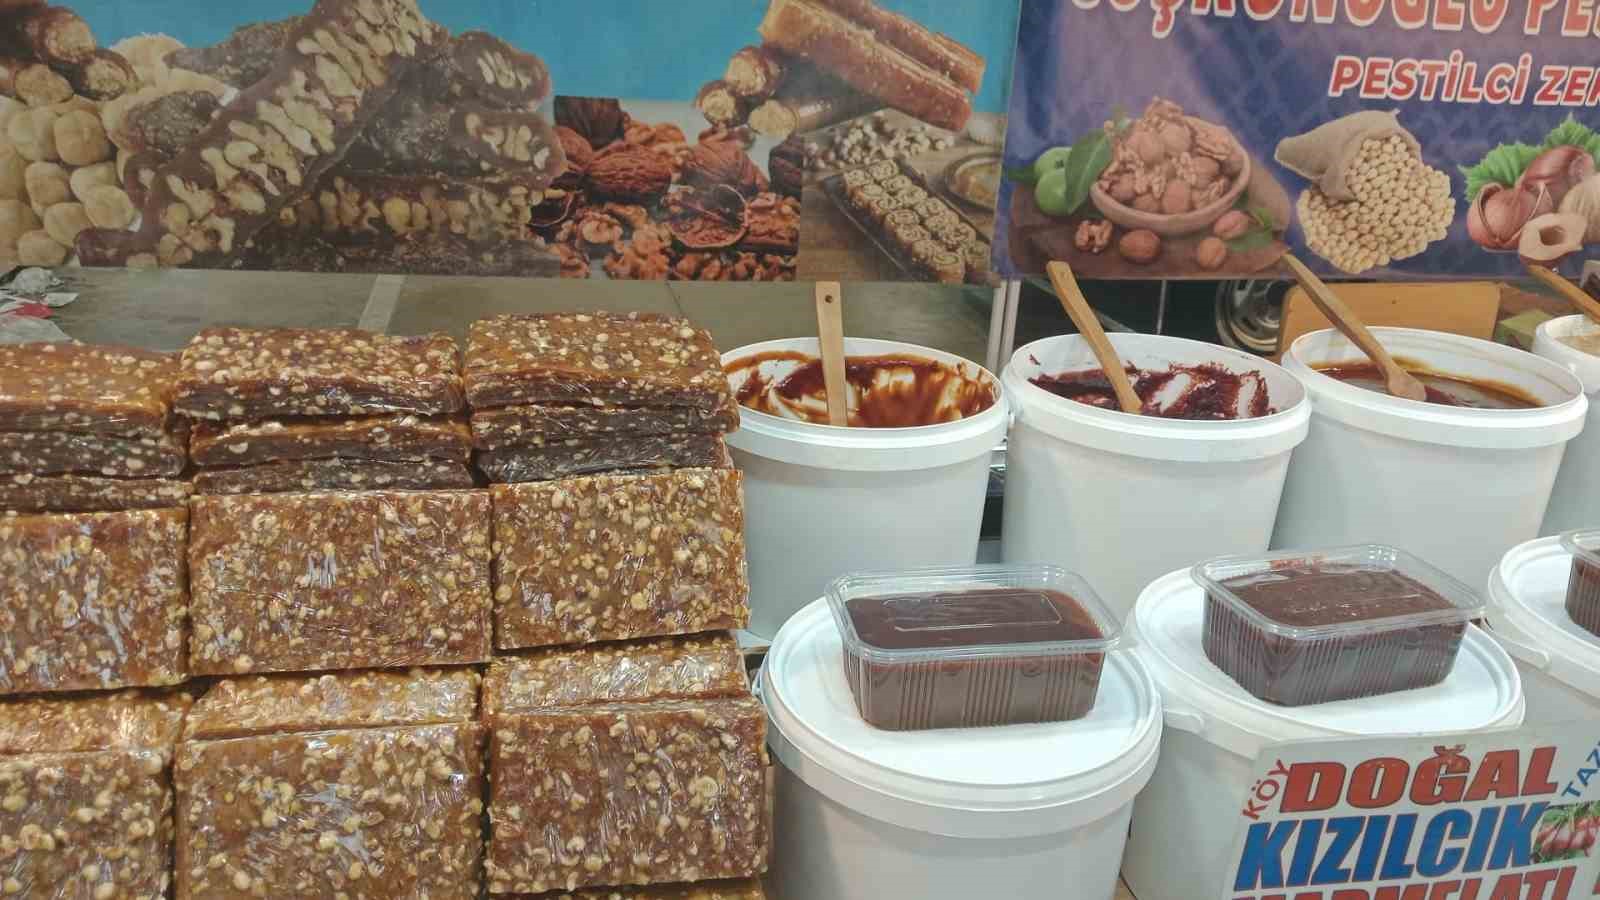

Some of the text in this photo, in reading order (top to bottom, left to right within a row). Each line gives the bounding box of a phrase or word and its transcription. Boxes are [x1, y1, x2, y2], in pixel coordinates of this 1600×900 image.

[1329, 51, 1531, 103] PESTİLCİ
[1242, 759, 1289, 820] KÖY
[1279, 744, 1558, 813] DOĞAL
[1233, 800, 1552, 892] KIZILCIK
